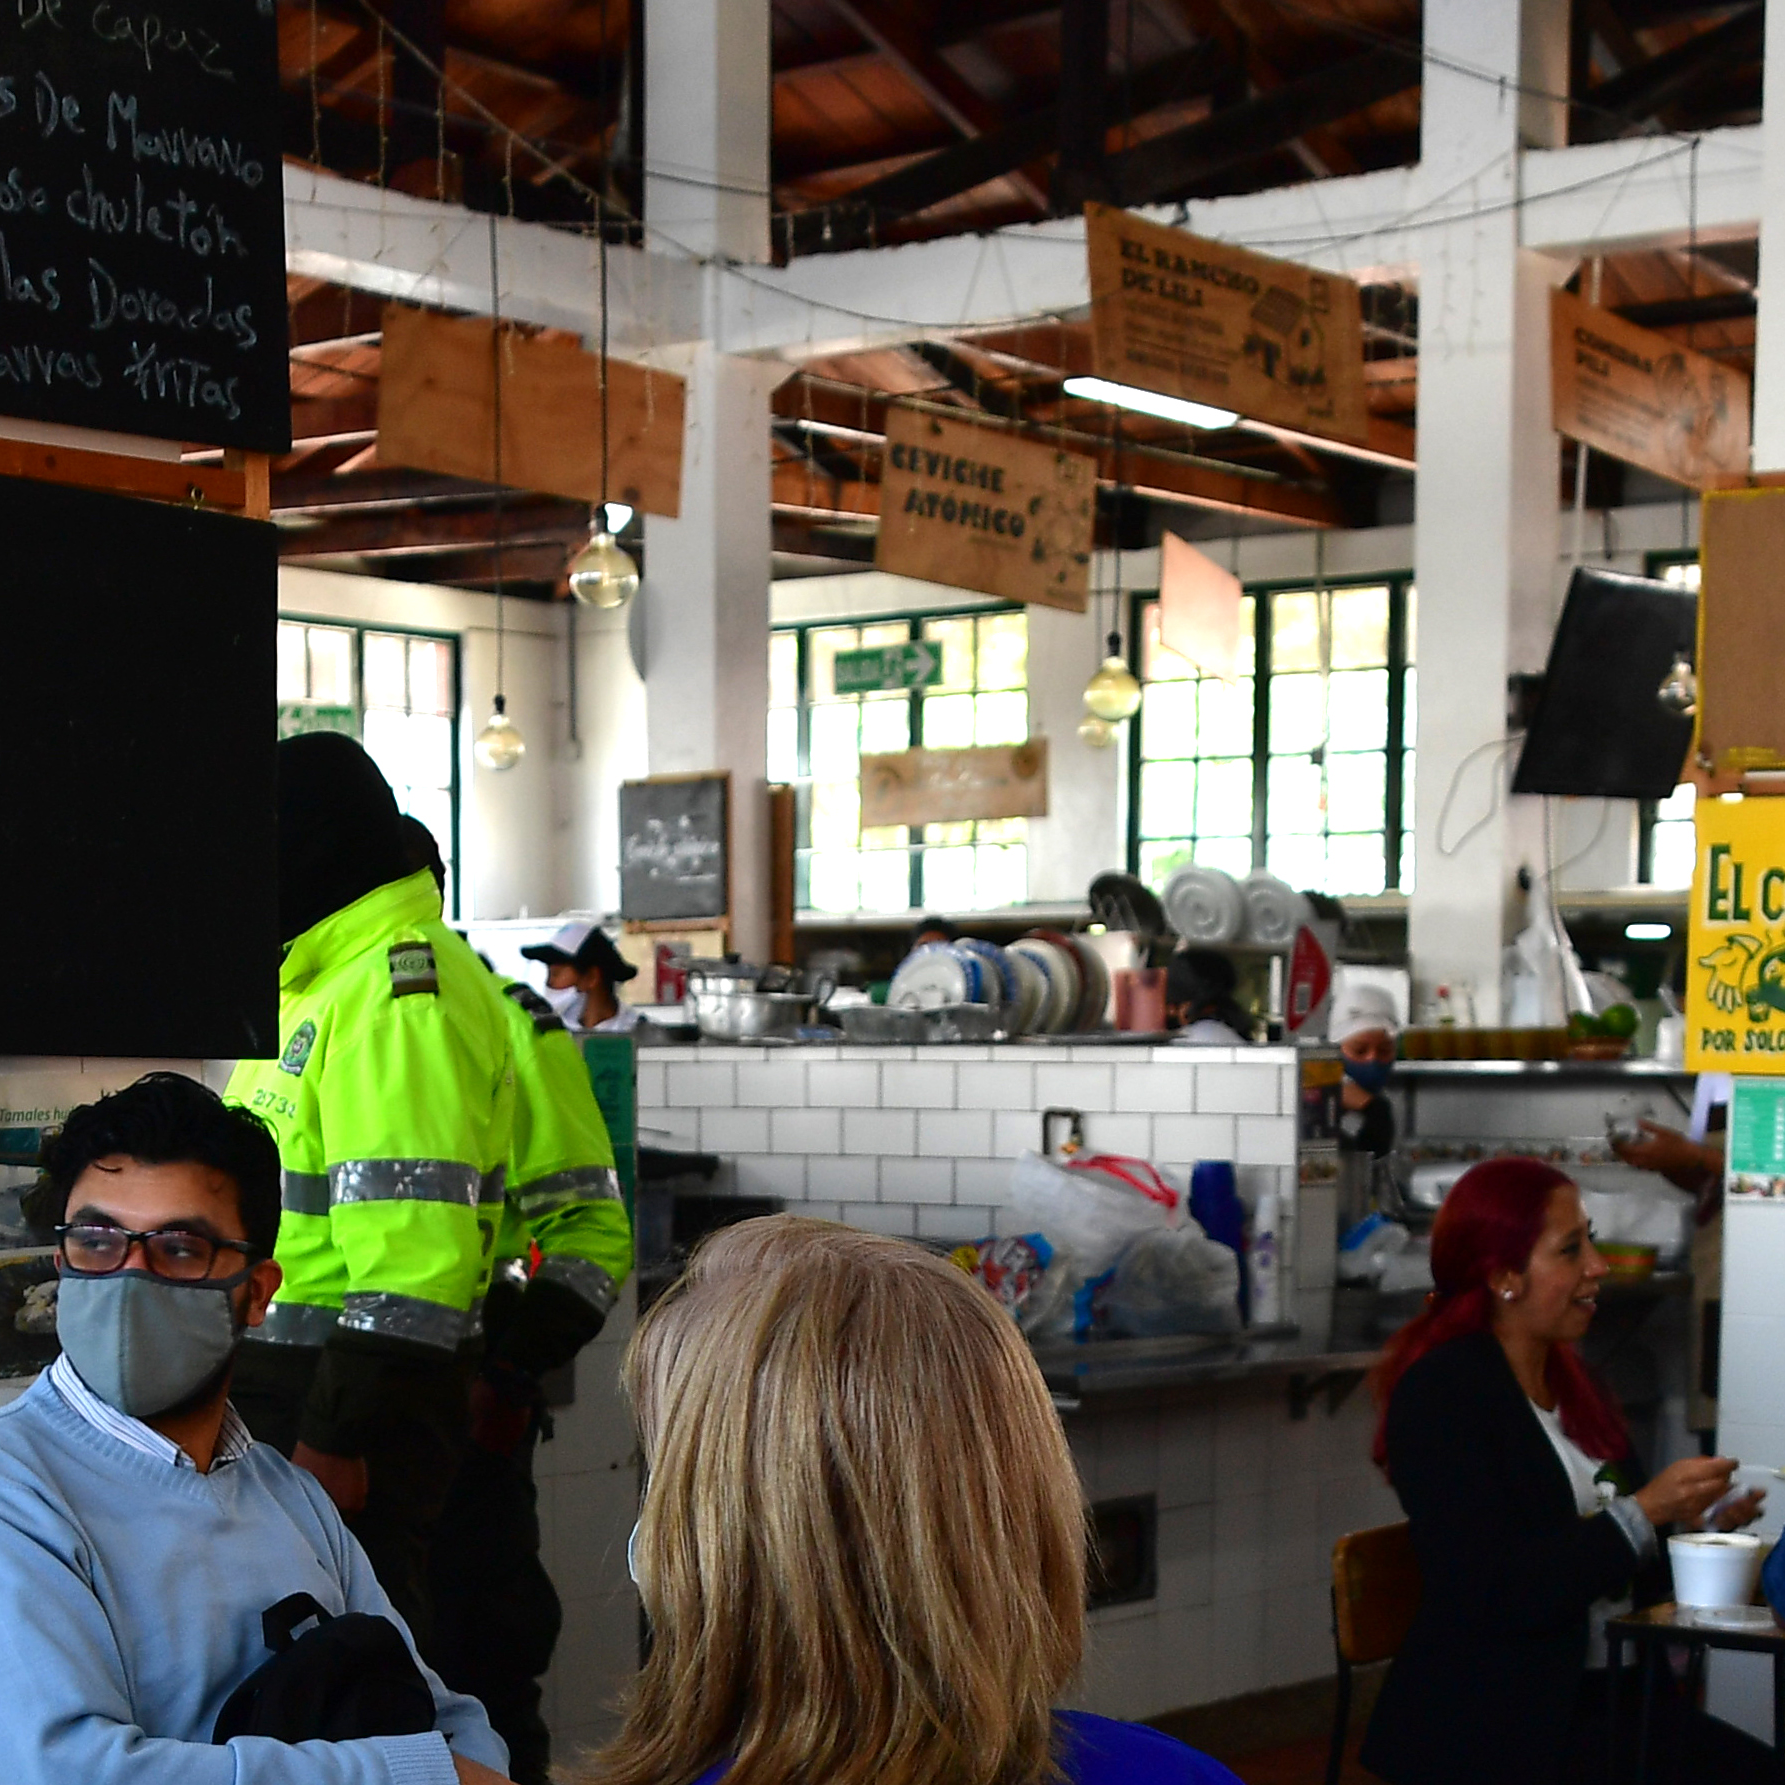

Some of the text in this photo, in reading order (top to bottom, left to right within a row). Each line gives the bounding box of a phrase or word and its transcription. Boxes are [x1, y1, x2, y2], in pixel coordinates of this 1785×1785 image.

[891, 442, 1005, 494] CEVICHE
[1706, 843, 1752, 923] EL
[1700, 1027, 1736, 1051] POR
